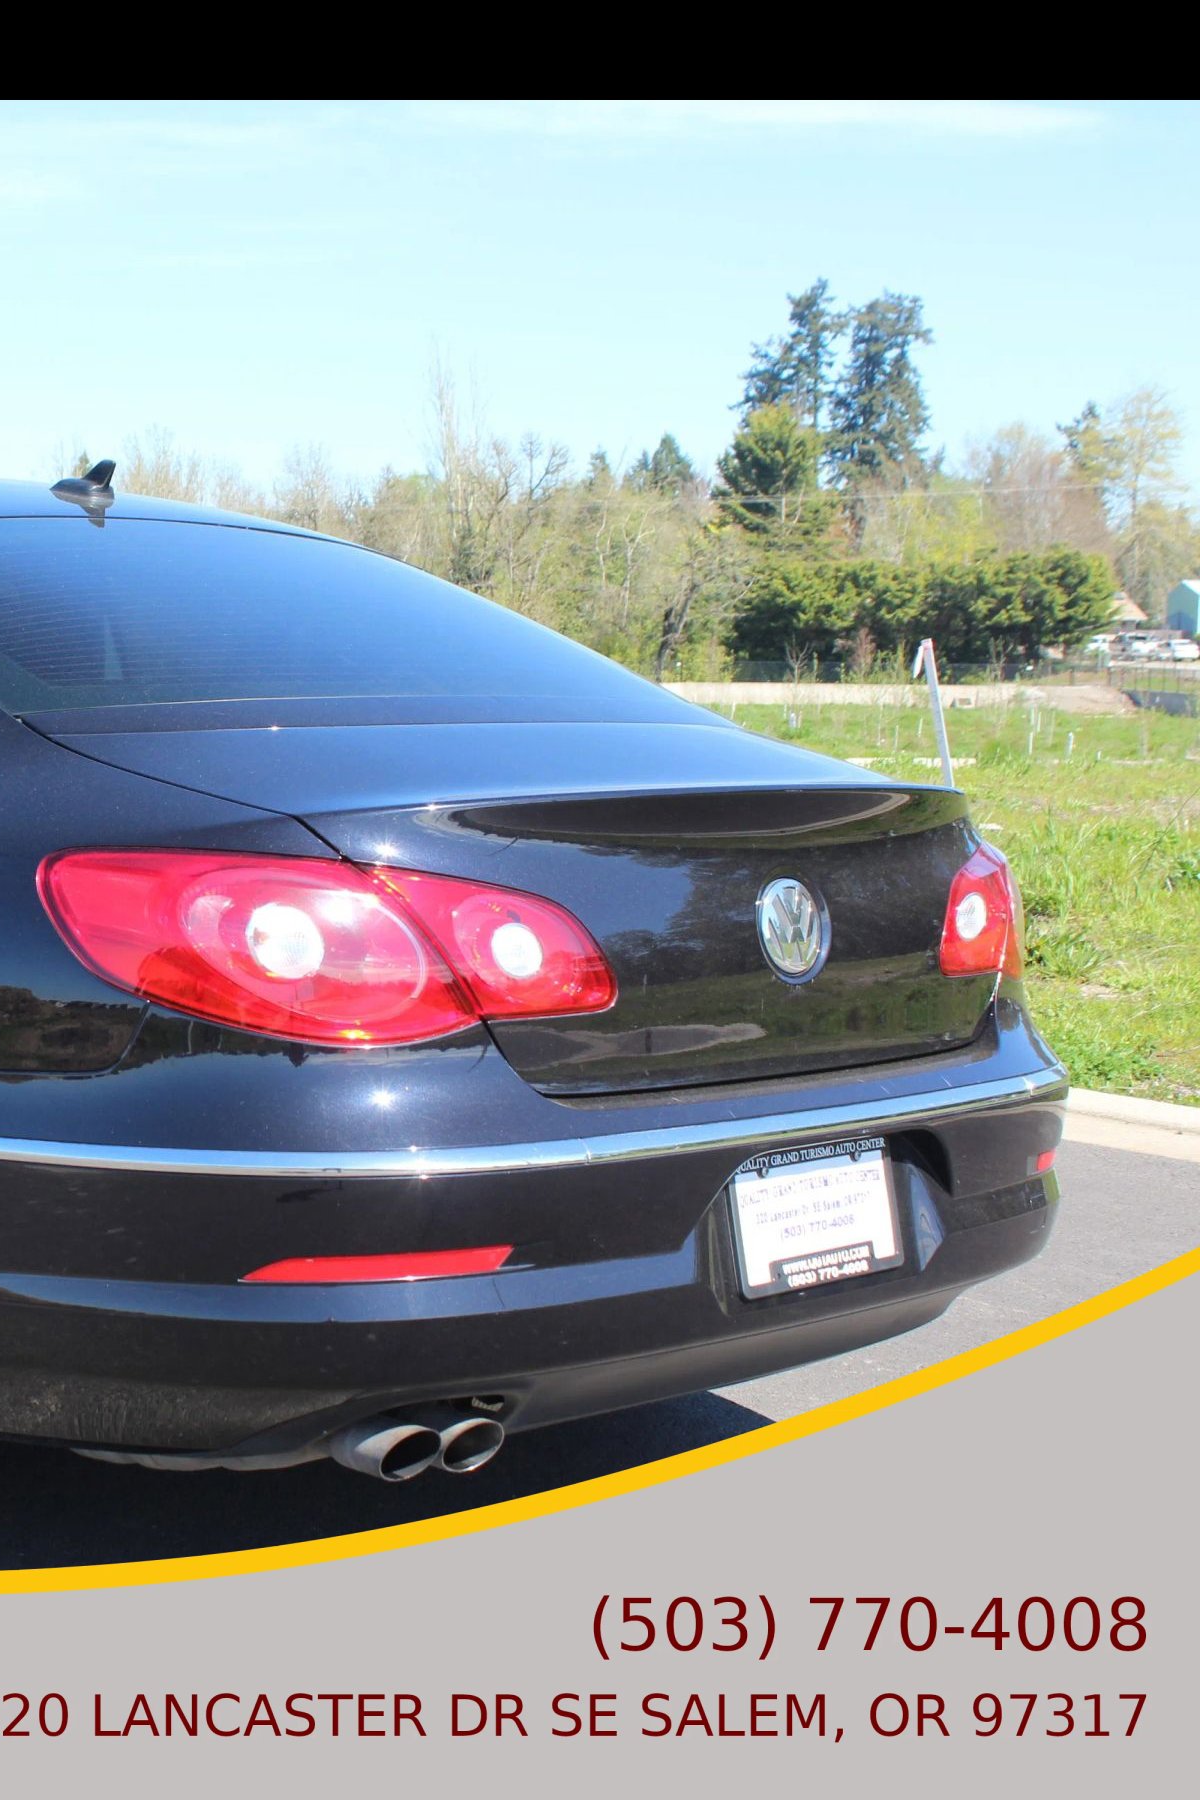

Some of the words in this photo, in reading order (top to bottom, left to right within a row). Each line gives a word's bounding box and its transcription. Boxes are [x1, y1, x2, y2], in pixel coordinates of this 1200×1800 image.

[770, 1151, 799, 1166] GRAND
[800, 1146, 834, 1160] TURISMO
[835, 1142, 856, 1155] AUTO
[856, 1137, 886, 1151] CENTER
[780, 1223, 806, 1242] (503)
[809, 1213, 855, 1233] 770-4008
